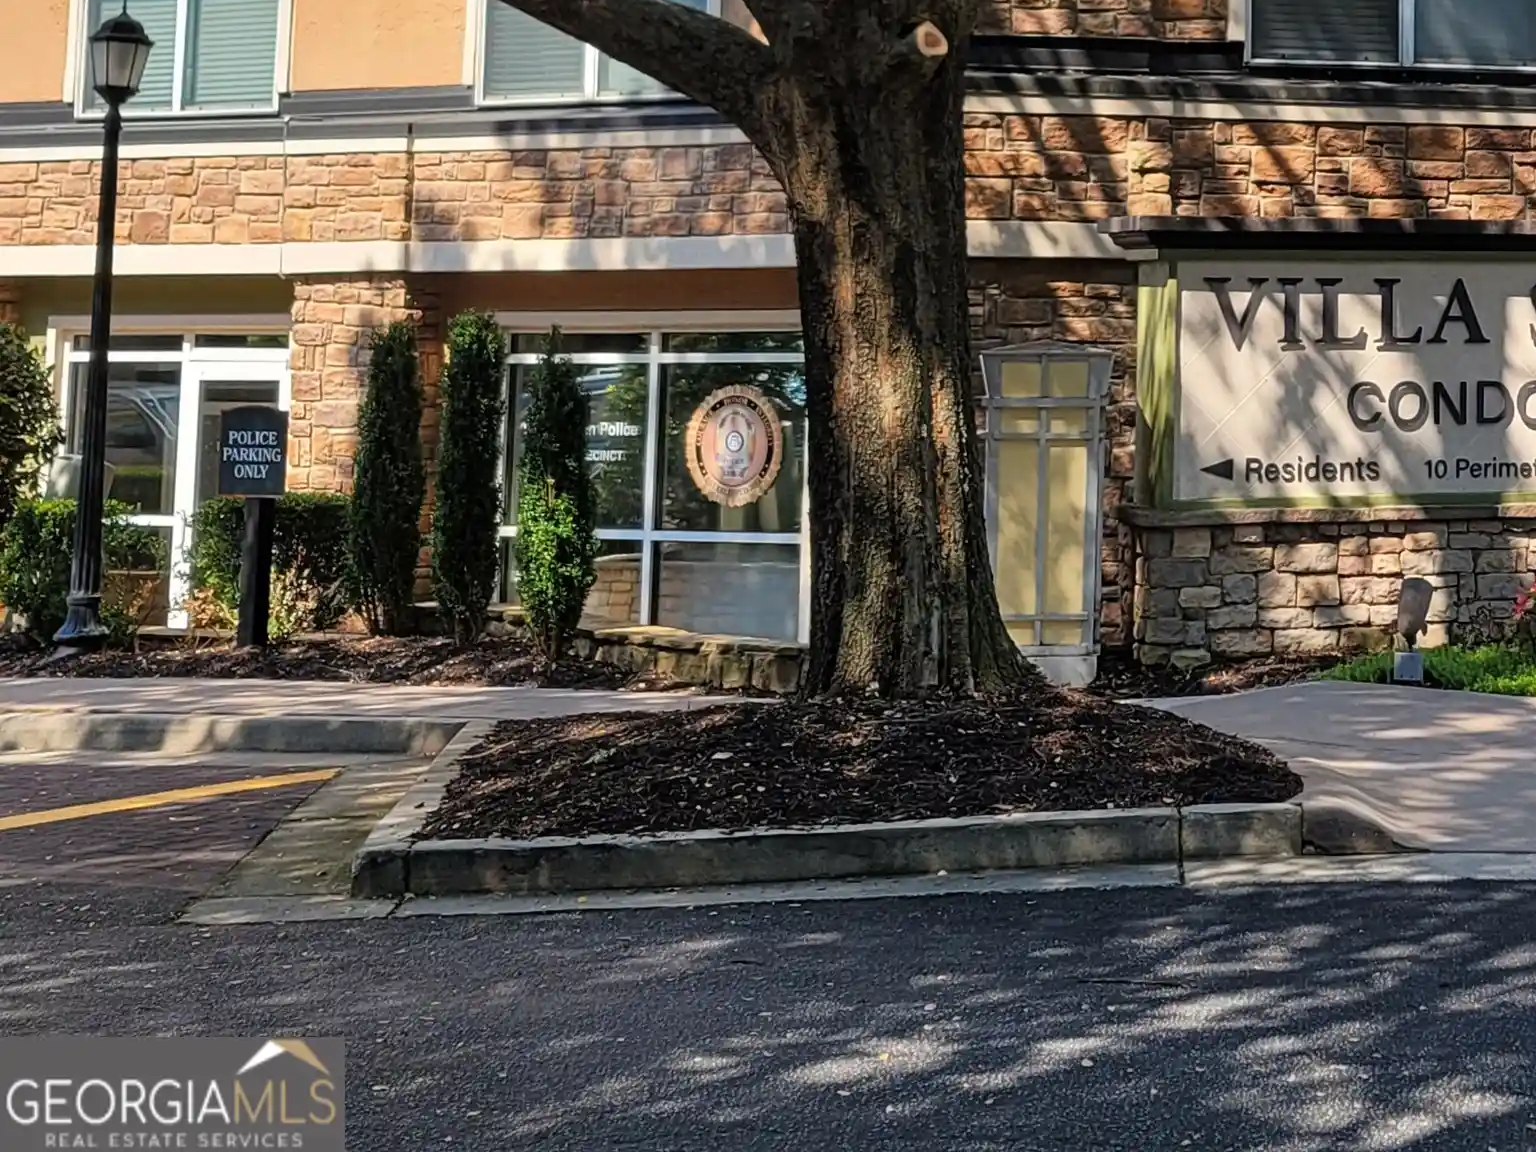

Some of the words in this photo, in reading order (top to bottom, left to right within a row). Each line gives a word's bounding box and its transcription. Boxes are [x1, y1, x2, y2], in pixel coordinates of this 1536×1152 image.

[1203, 277, 1490, 350] VILLA
[600, 421, 640, 436] Police
[228, 430, 278, 445] POLICE
[223, 447, 282, 462] PARKING
[234, 464, 269, 479] ONLY
[1245, 454, 1380, 483] Residents
[1424, 459, 1448, 479] 10
